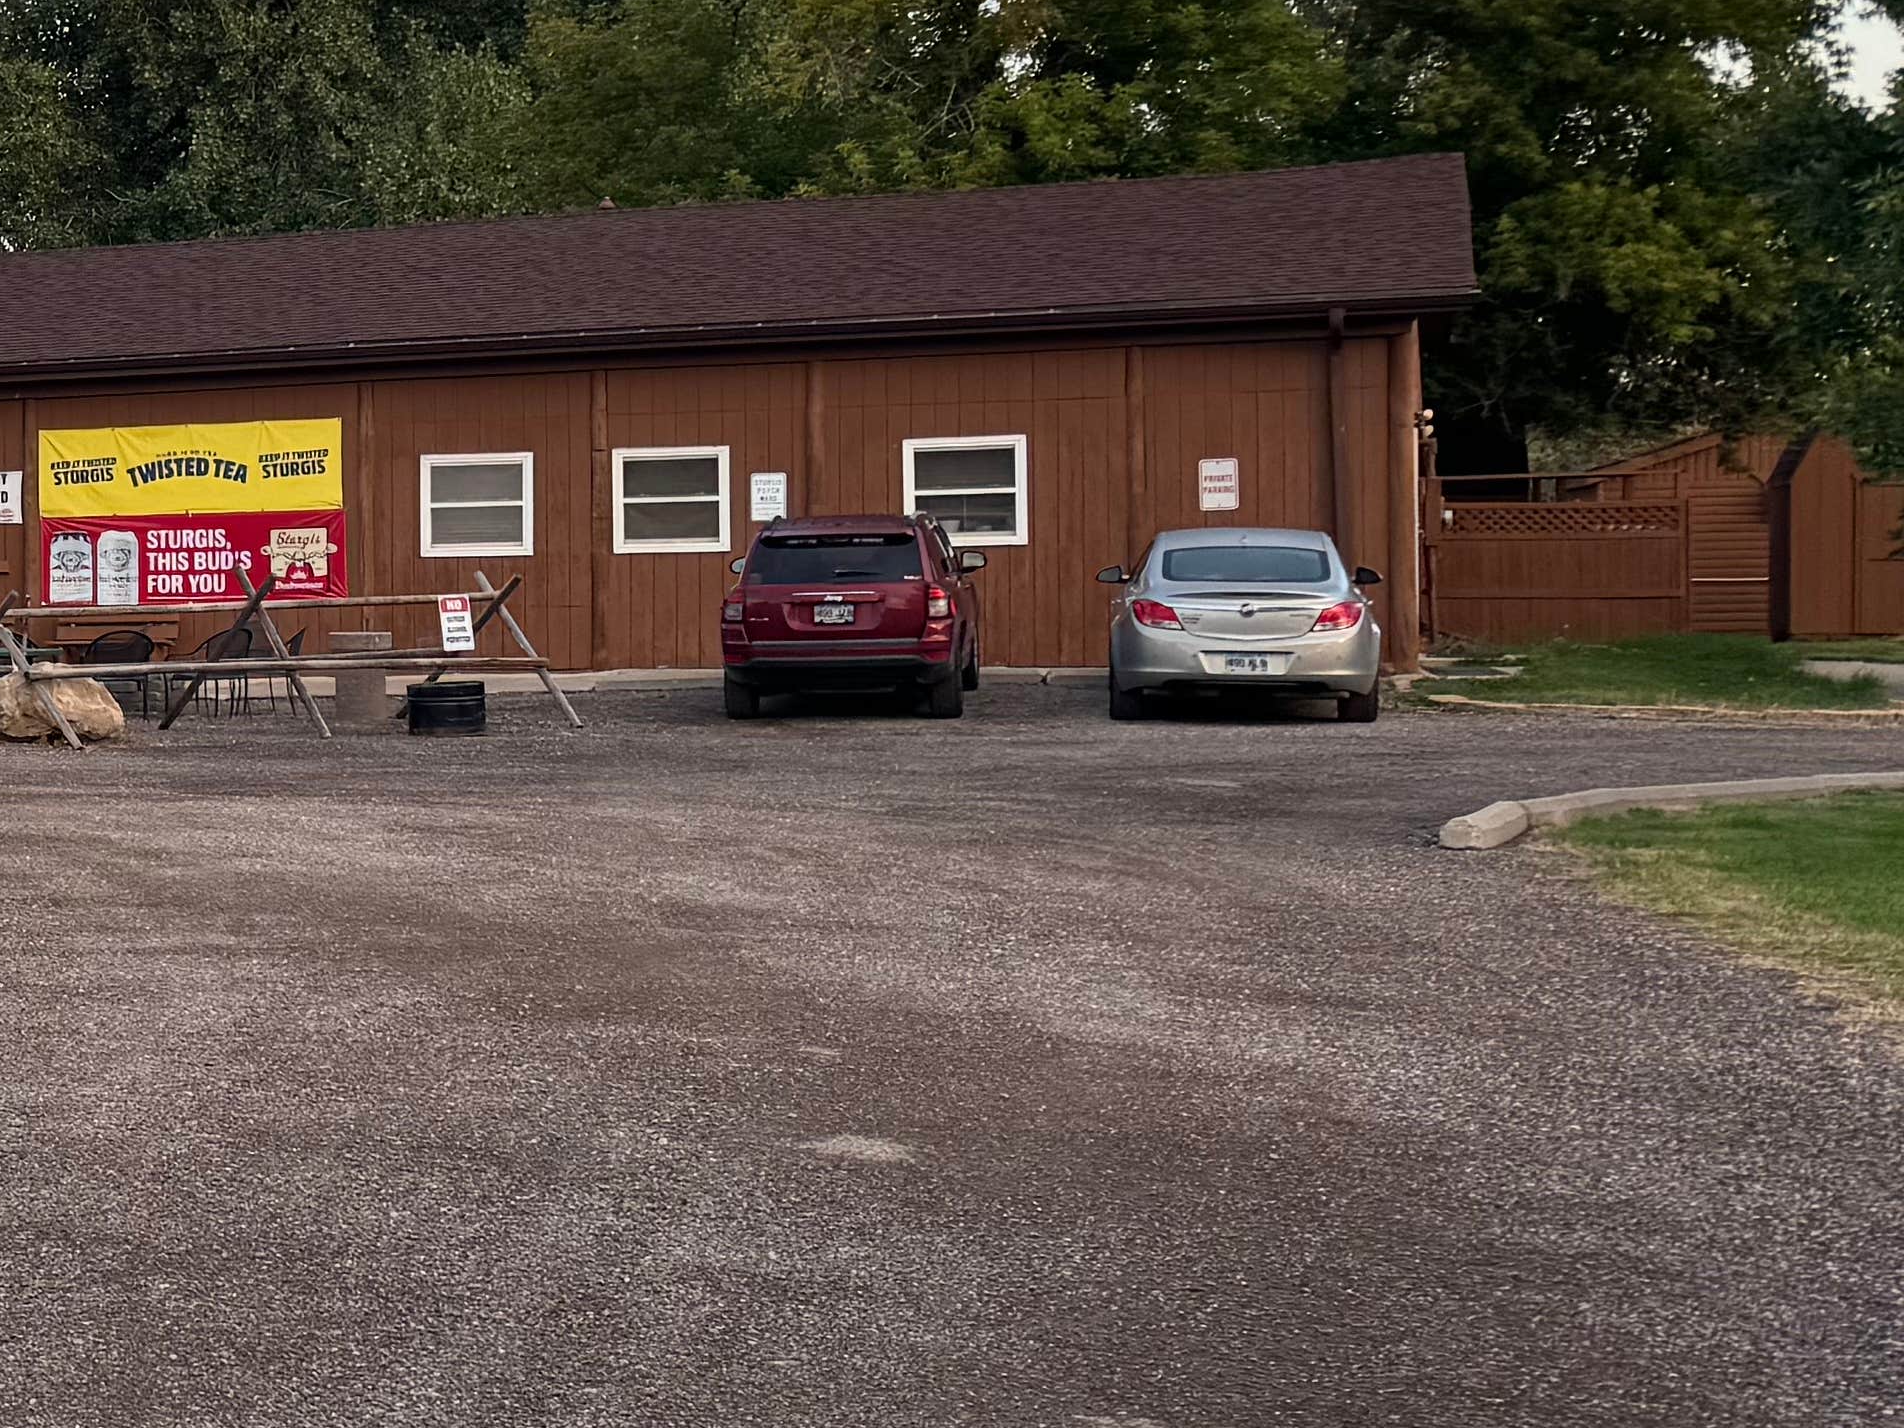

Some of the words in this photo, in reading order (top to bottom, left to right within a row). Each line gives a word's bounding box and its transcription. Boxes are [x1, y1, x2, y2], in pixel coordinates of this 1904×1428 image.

[54, 467, 114, 486] STURGIS
[126, 457, 210, 487] TWISTED
[212, 458, 248, 484] TEA
[262, 460, 326, 479] STURGIS
[146, 528, 232, 550] STURGIS,
[146, 552, 190, 571] THIS
[193, 550, 252, 571] BUD'S
[147, 574, 184, 594] FOR
[188, 573, 226, 593] YOU
